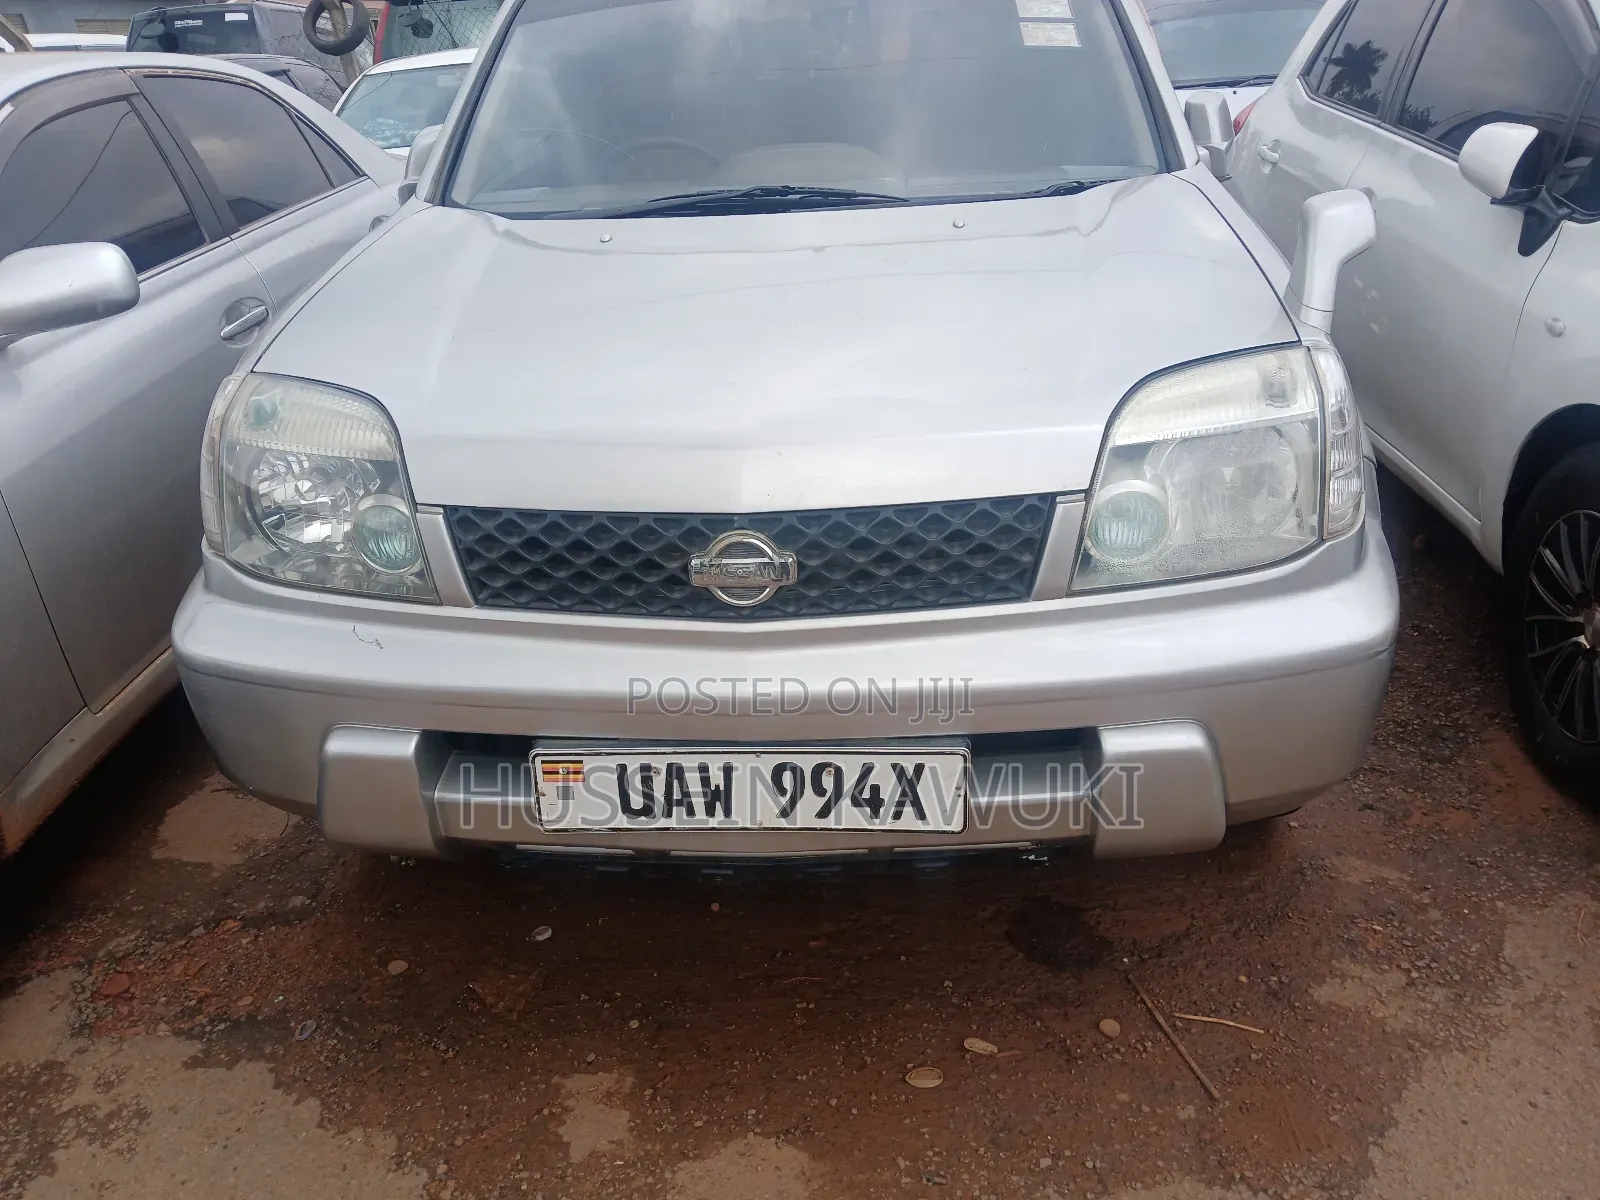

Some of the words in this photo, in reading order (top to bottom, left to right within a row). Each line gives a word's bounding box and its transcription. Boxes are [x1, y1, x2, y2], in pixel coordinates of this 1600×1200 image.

[703, 562, 783, 581] NISSAN
[616, 762, 733, 819] UAW
[770, 762, 926, 820] 994X
